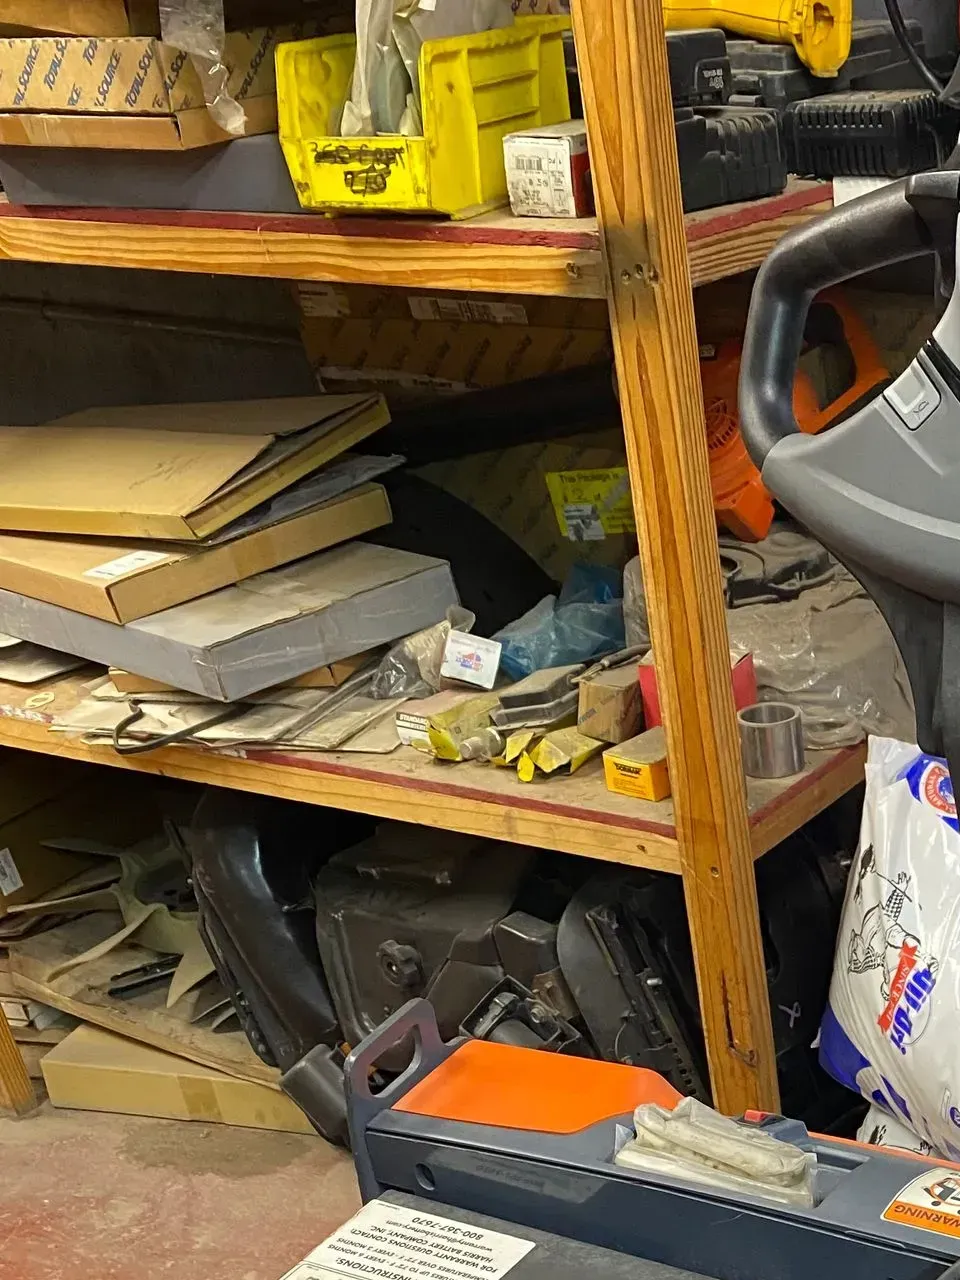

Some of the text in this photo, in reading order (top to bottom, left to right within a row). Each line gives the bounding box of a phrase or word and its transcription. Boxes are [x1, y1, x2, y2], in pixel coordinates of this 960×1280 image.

[19, 42, 40, 86] SOURCE
[101, 48, 121, 99] SOURCE
[409, 1216, 485, 1240] 800-367-7670
[366, 1224, 494, 1263] HARRIS BATTERY COMPANY, INC.
[386, 1238, 435, 1255] QUESTIONS
[432, 1251, 481, 1268] WARRANTY
[478, 1264, 499, 1273] FOR
